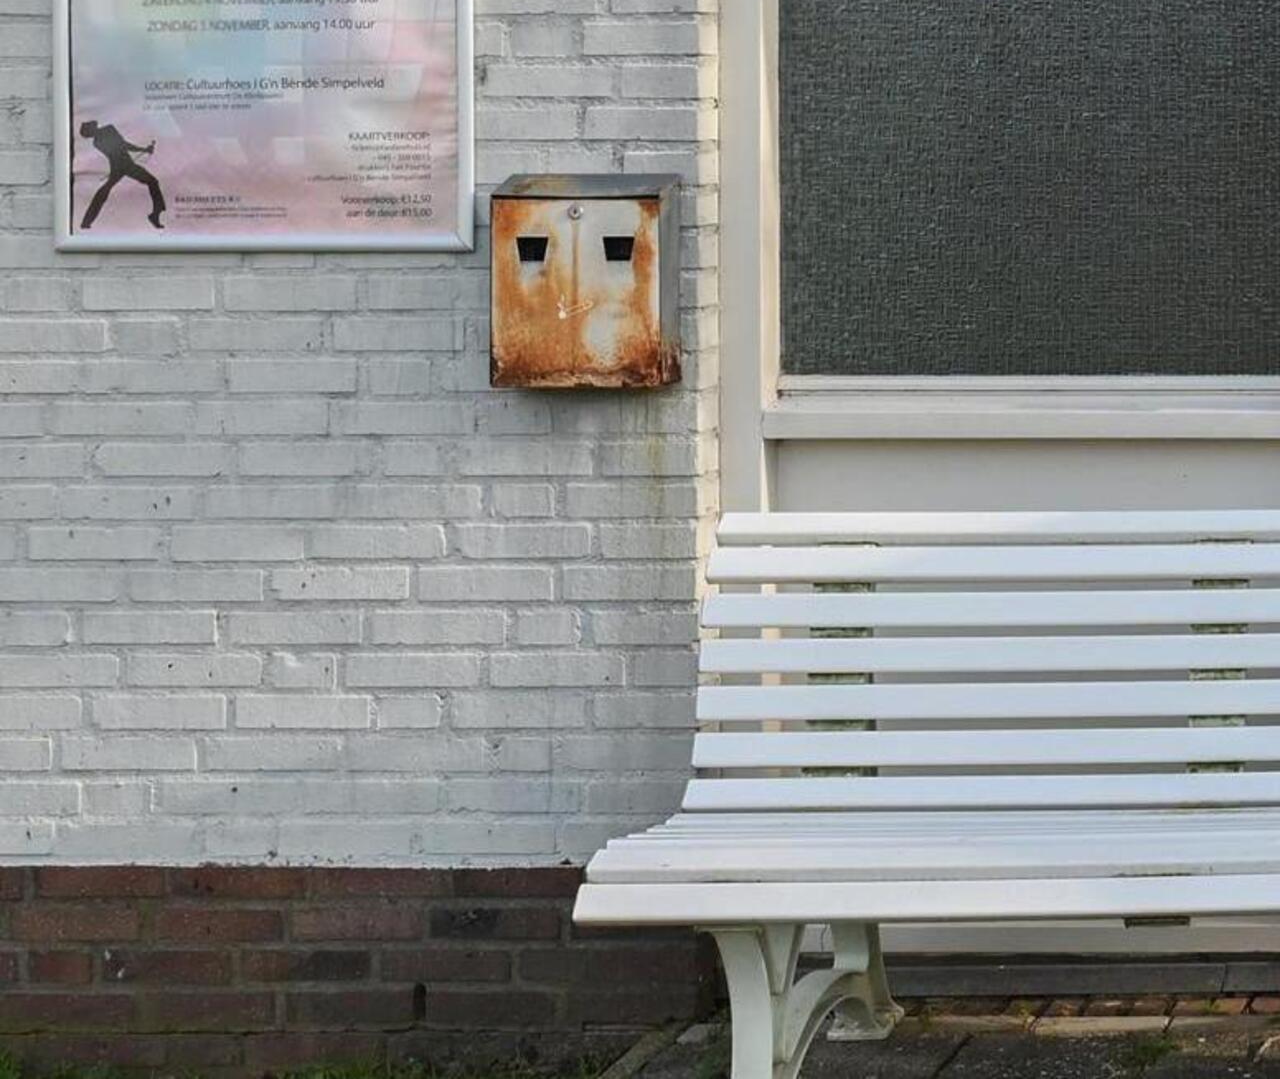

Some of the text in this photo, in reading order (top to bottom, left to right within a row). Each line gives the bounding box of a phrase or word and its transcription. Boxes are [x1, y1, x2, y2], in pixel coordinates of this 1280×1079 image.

[273, 20, 321, 33] aanvang
[354, 20, 377, 29] uur
[186, 77, 252, 90] Cultuurhoes
[321, 74, 386, 91] Simpelveld
